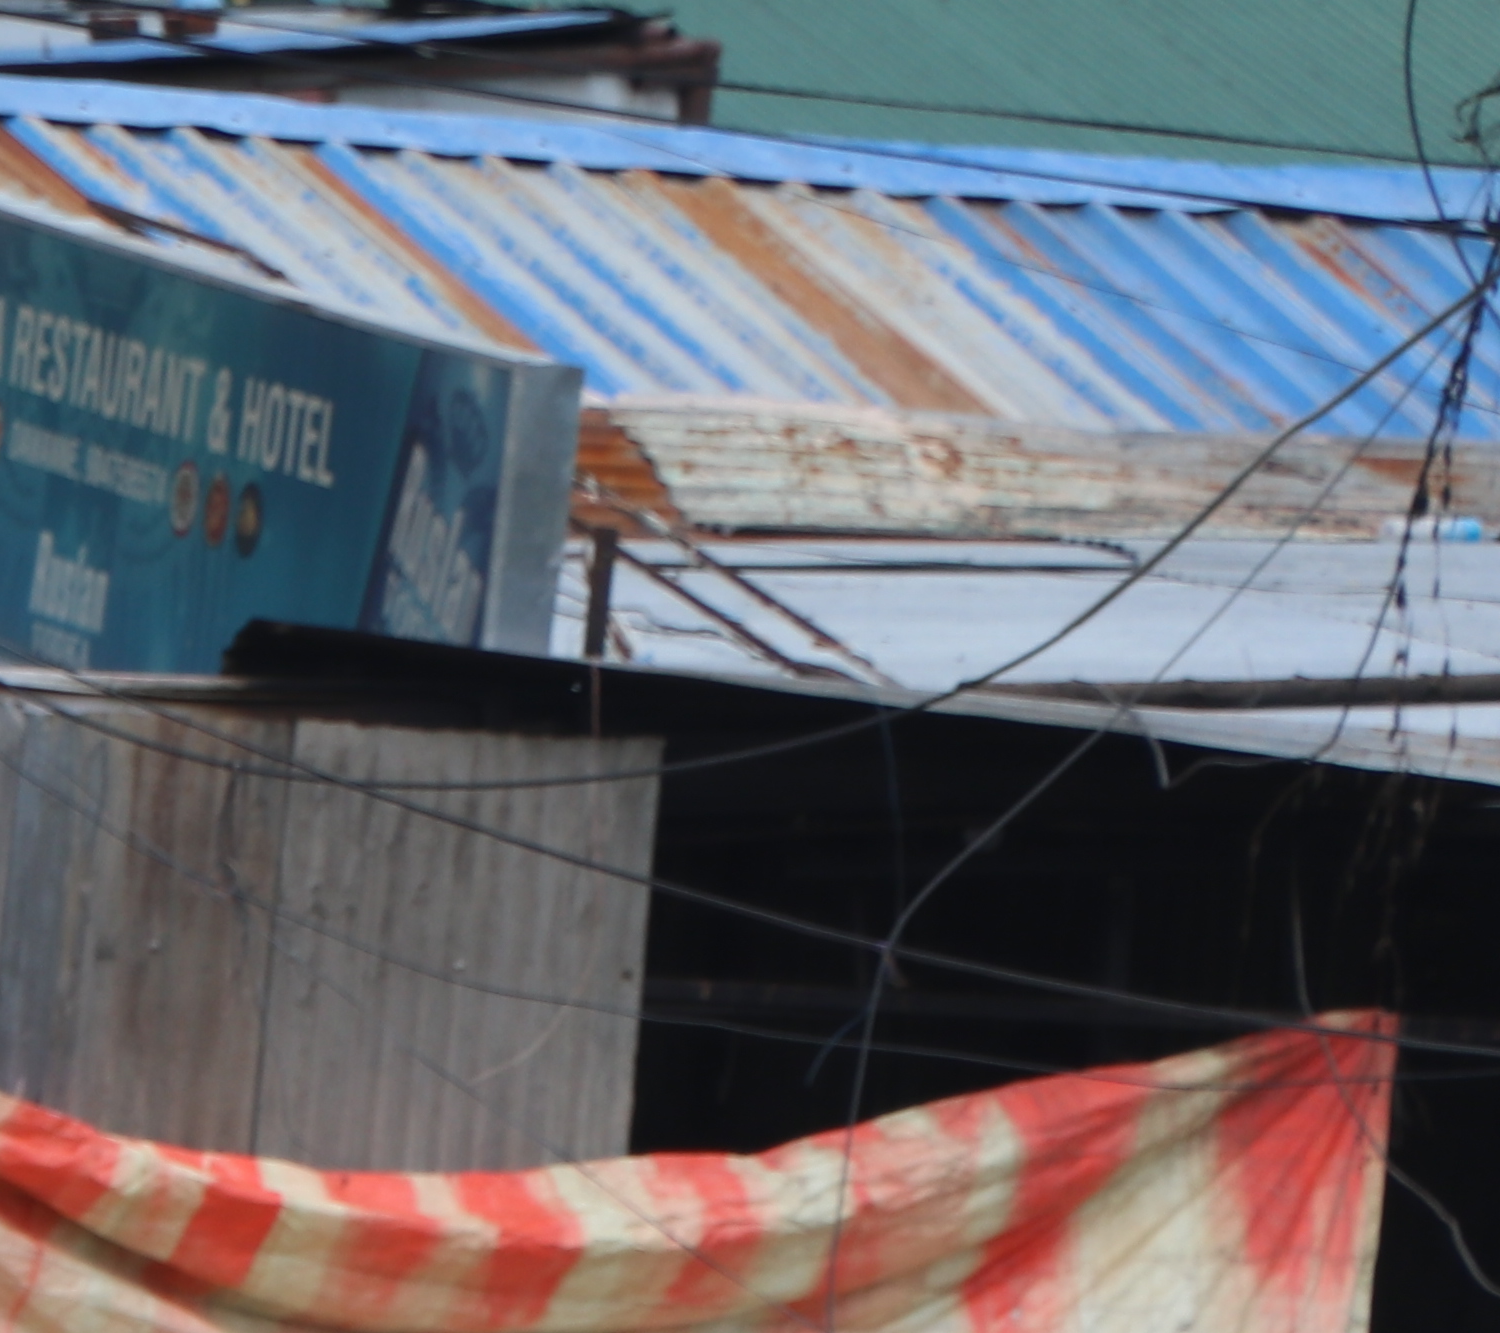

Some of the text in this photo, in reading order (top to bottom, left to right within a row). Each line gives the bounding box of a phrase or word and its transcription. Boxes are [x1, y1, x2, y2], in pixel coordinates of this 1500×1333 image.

[8, 305, 208, 445] RESTAURANT
[206, 367, 234, 454] &
[236, 375, 336, 489] HOTEL
